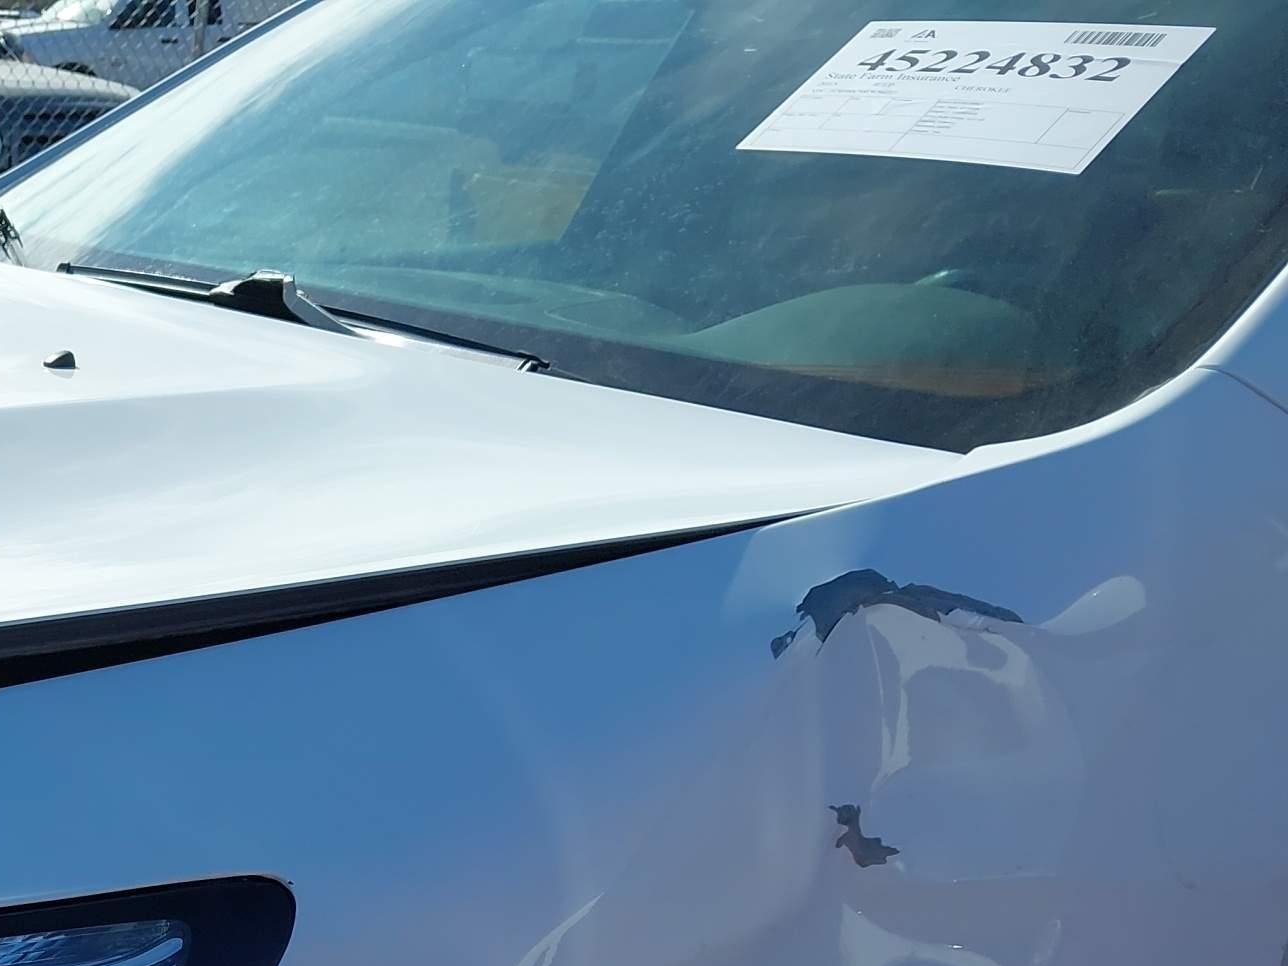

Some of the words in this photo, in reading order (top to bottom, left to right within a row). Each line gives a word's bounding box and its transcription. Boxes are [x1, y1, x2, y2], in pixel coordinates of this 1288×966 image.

[858, 48, 1131, 82] 45224832
[827, 71, 858, 80] State
[896, 73, 961, 83] Insurance
